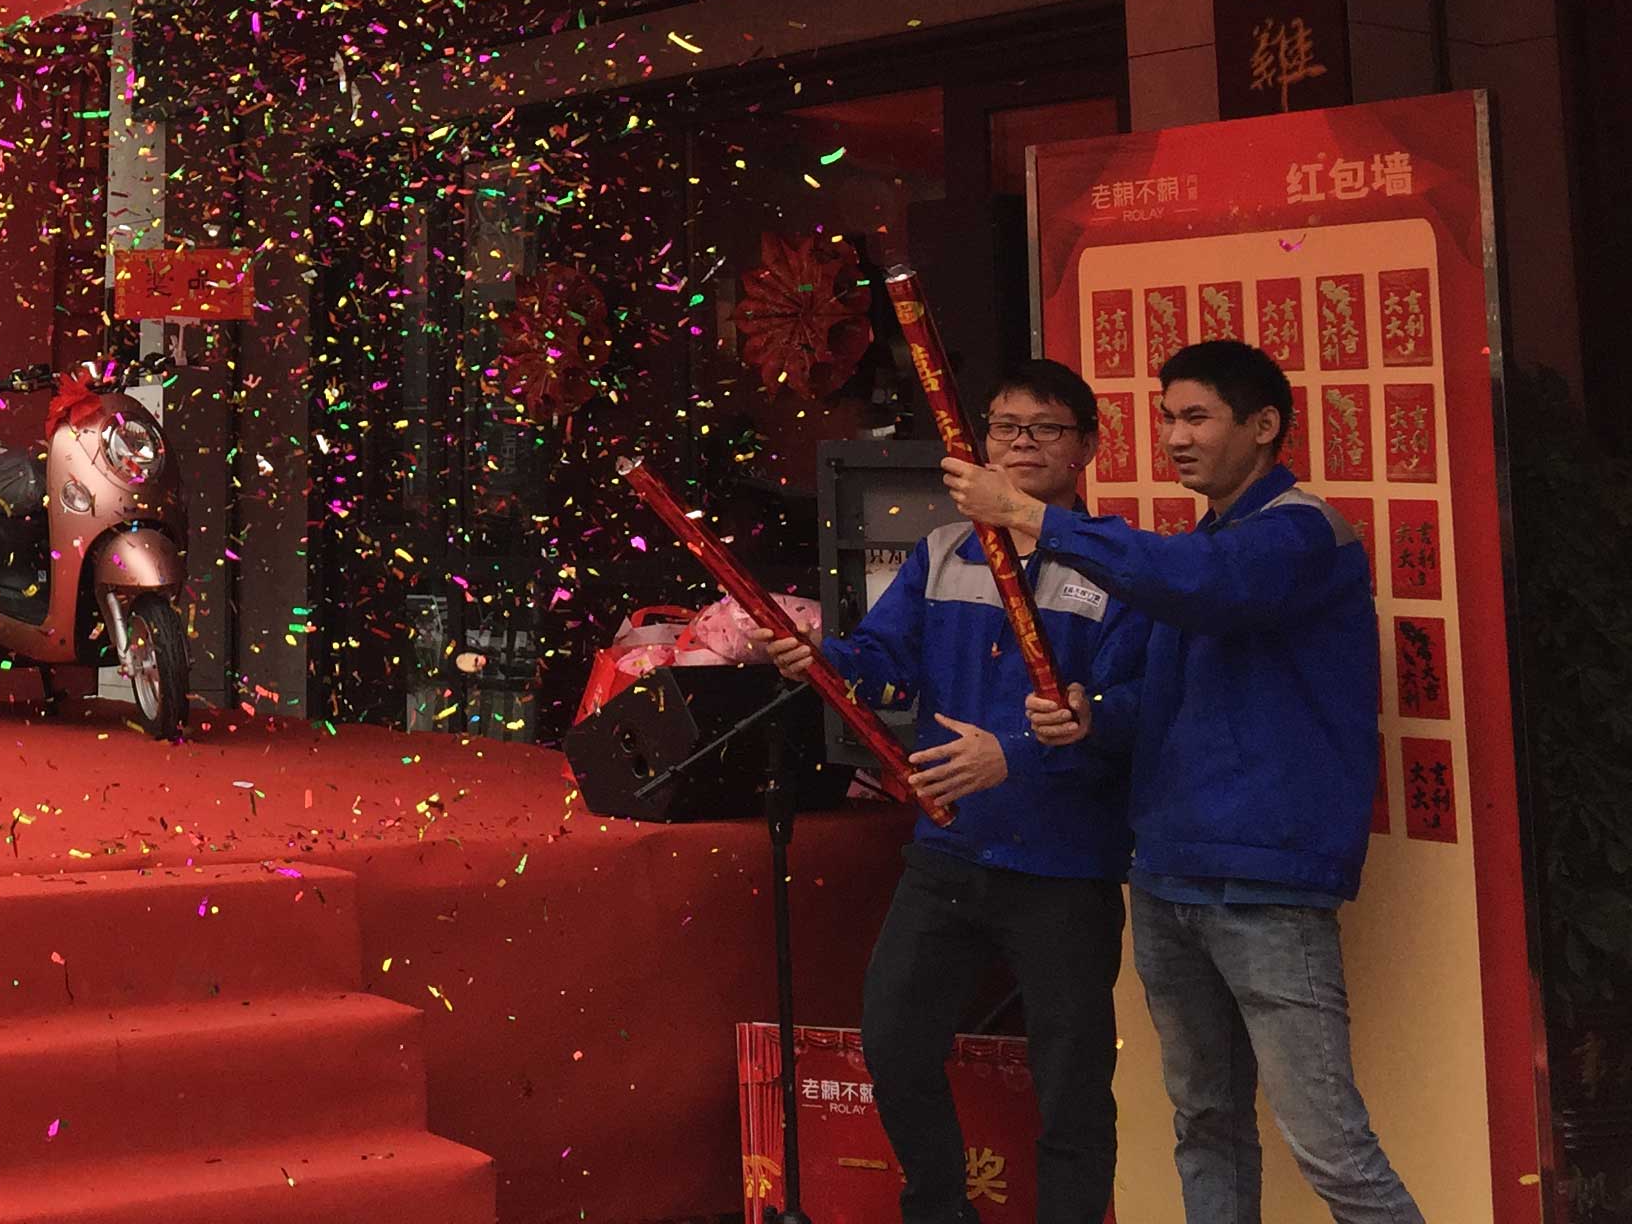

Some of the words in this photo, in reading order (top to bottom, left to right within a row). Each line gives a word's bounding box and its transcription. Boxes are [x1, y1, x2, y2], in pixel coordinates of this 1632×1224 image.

[1285, 151, 1414, 205] 红包墙
[1122, 206, 1165, 223] ROLAY
[830, 1102, 866, 1115] ROLAY
